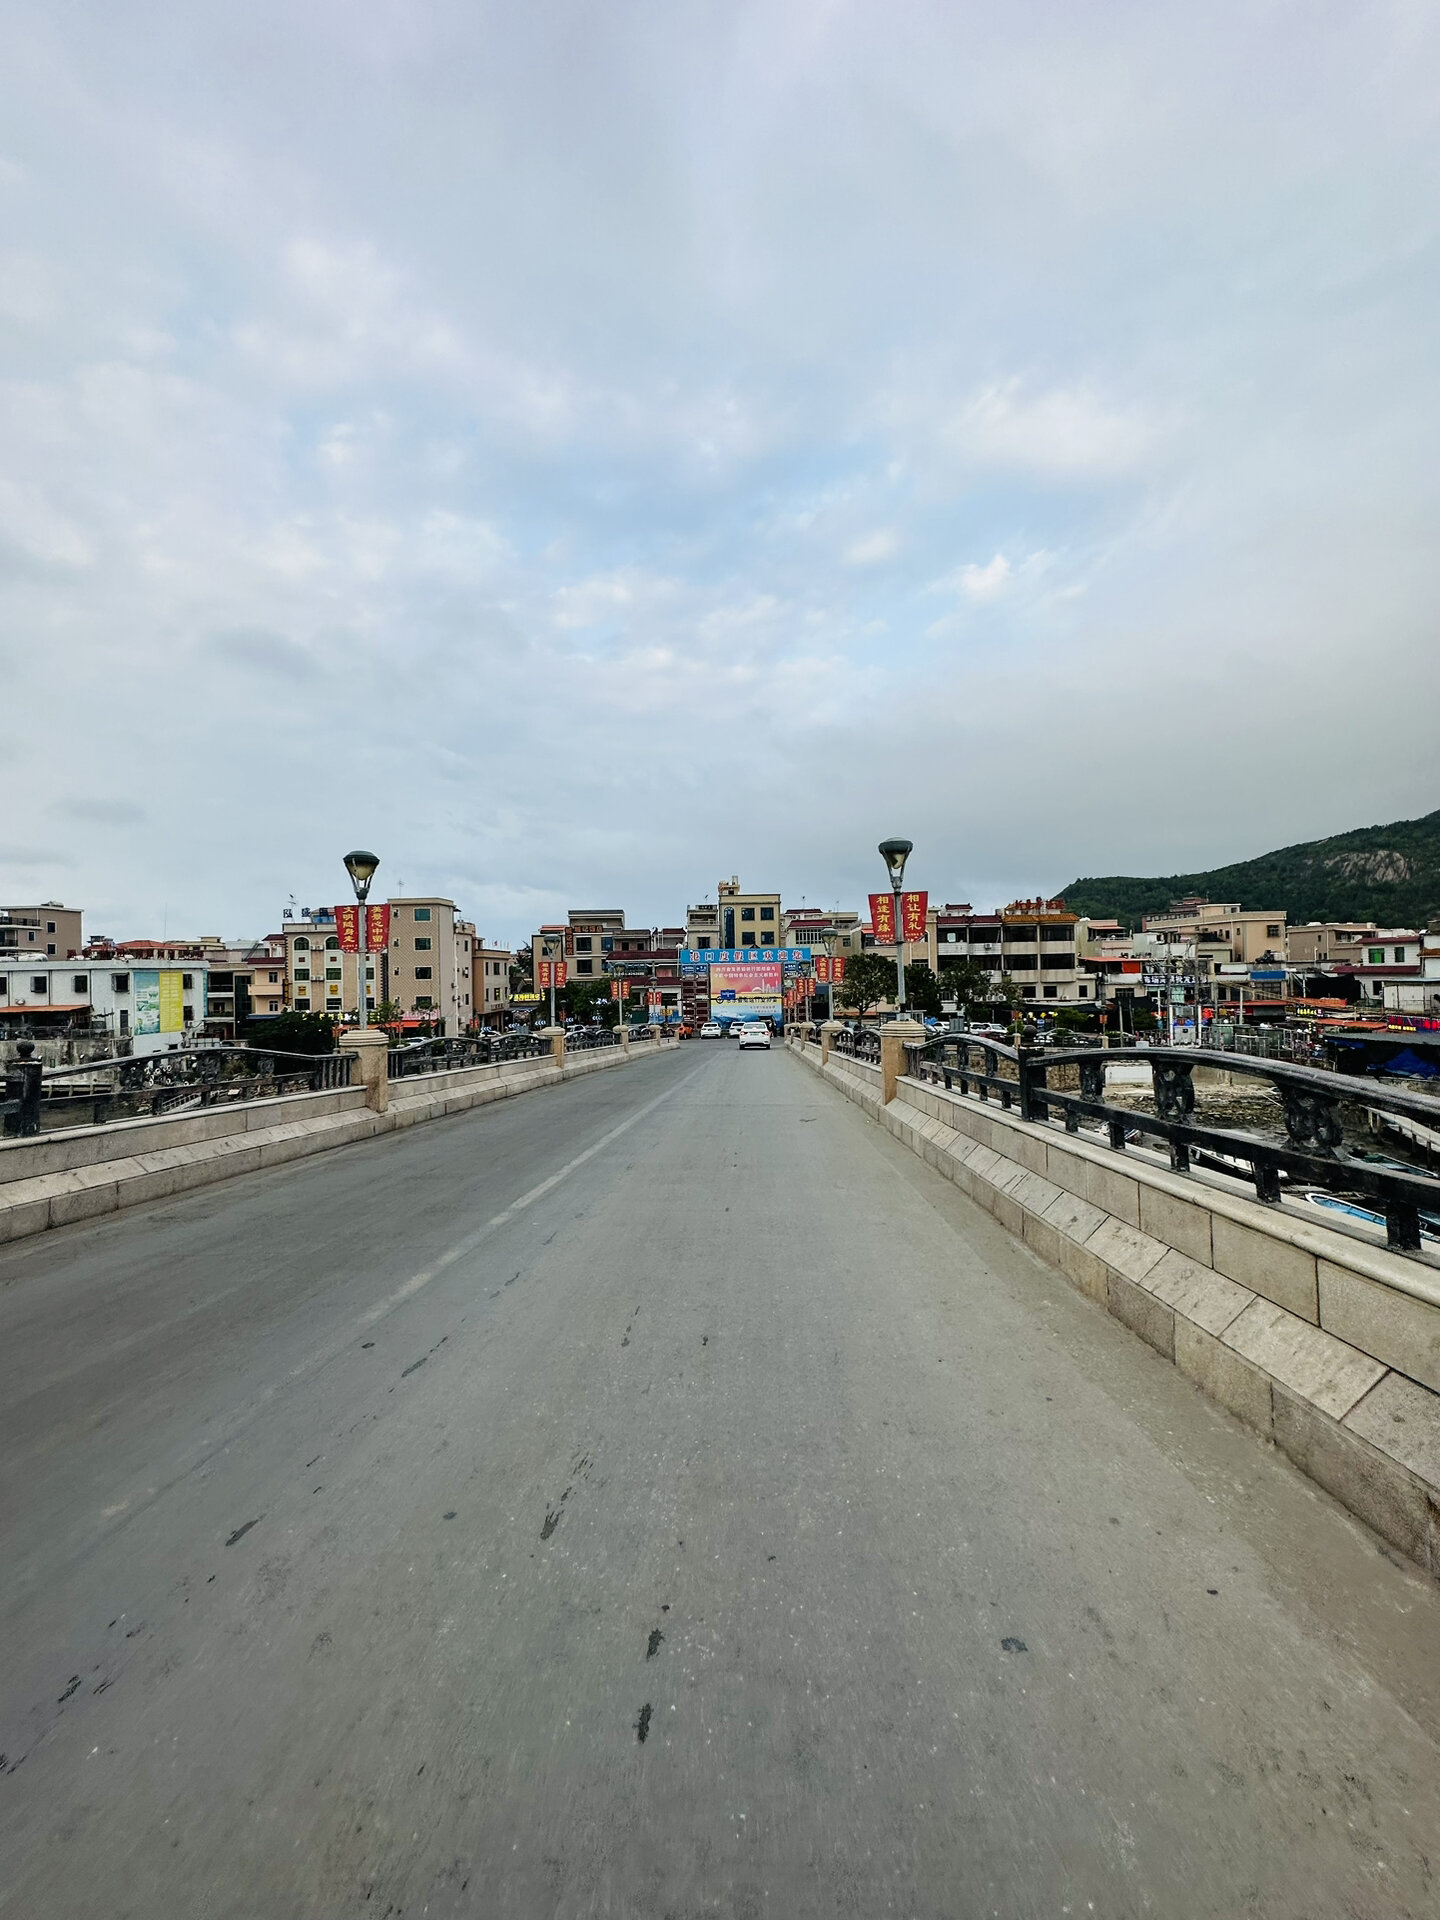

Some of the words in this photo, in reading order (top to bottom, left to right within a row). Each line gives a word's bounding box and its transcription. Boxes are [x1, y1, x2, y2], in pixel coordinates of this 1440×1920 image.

[342, 906, 355, 943] 文明随身走
[371, 905, 384, 943] 美景心中留
[876, 895, 891, 933] 相逢有缘
[906, 893, 922, 931] 相让有礼
[690, 949, 804, 963] 港口度假区欢迎您
